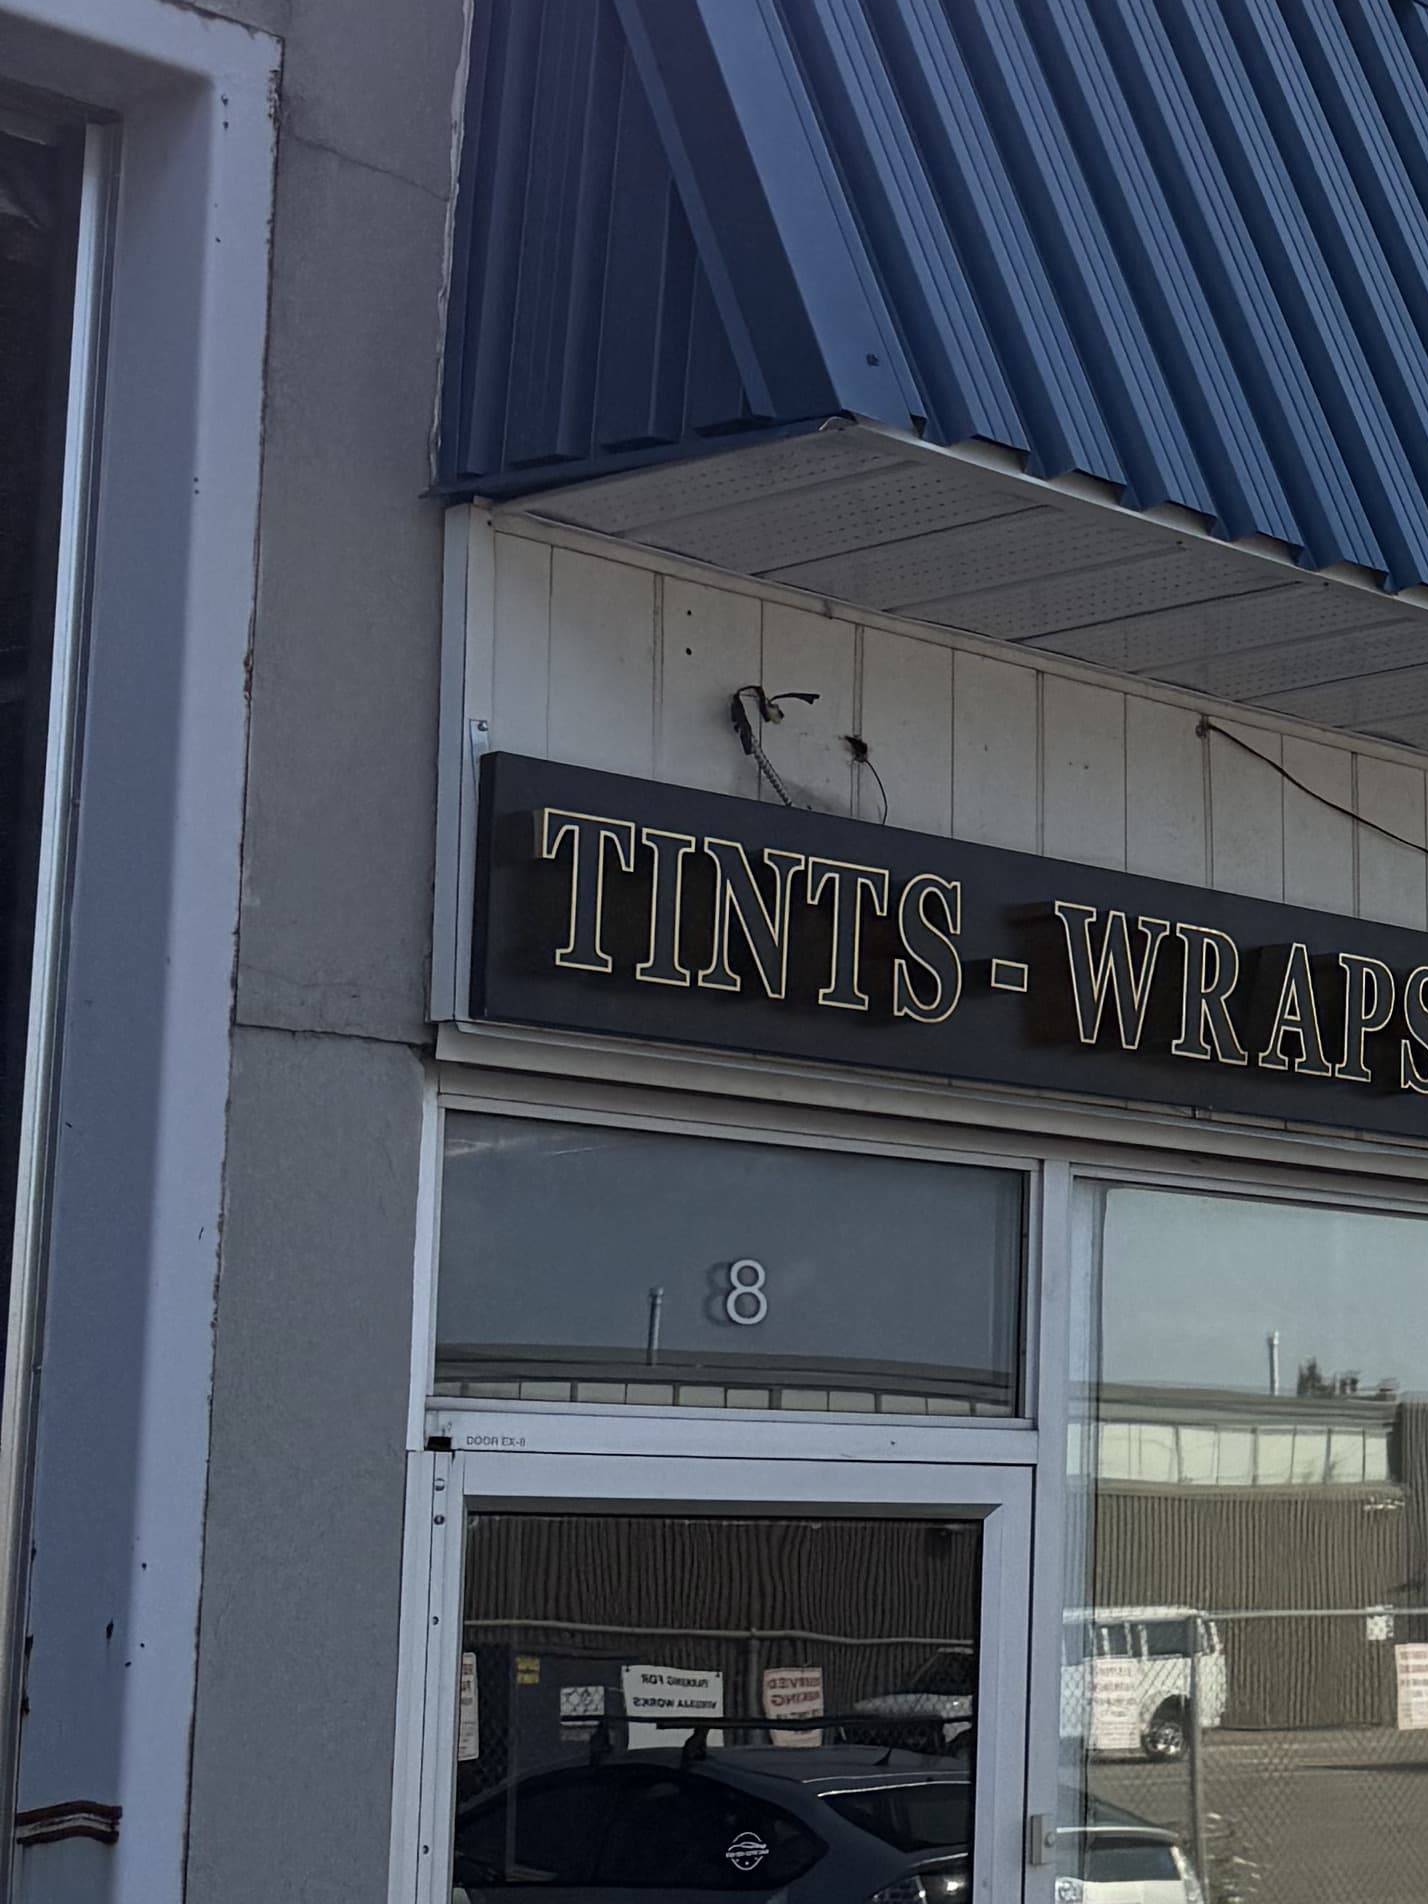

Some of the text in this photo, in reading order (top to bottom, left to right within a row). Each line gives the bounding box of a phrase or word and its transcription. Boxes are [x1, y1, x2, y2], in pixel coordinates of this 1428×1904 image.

[541, 806, 962, 1024] TINTS
[726, 1258, 769, 1326] 8
[466, 1435, 499, 1447] DOOR
